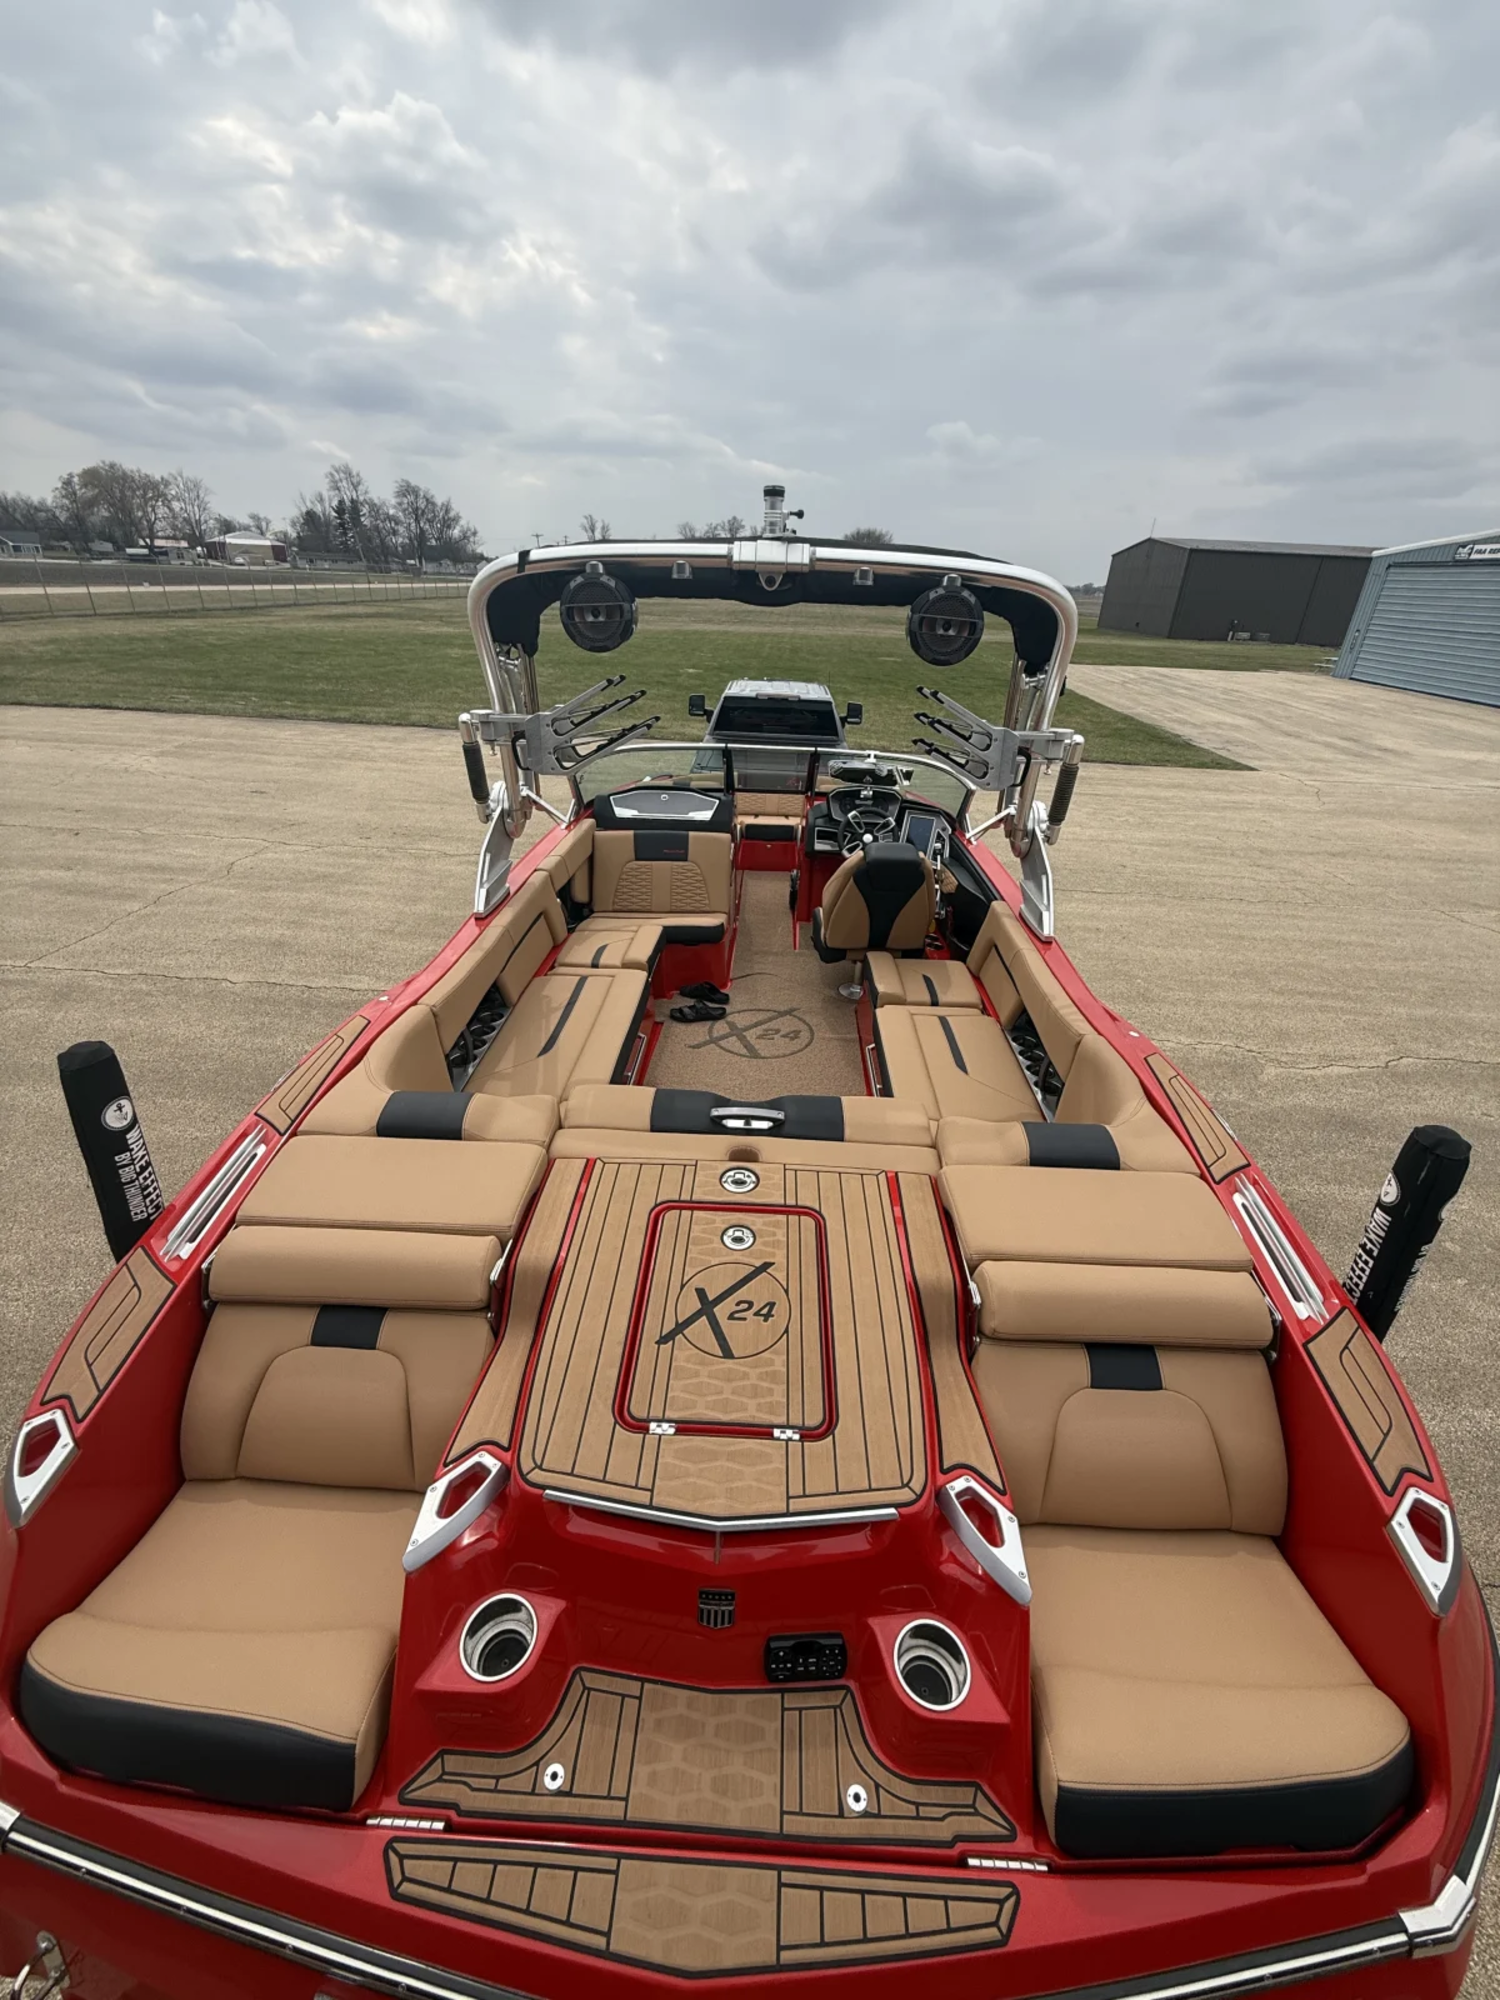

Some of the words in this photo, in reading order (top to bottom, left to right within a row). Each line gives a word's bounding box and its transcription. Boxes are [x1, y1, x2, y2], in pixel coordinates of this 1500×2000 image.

[114, 1151, 133, 1167] BY
[118, 1165, 137, 1183] BIG
[126, 1124, 150, 1172] WAKE
[138, 1166, 164, 1220] EFFECT
[123, 1180, 148, 1222] THUNDER
[1360, 1207, 1392, 1257] WAKE
